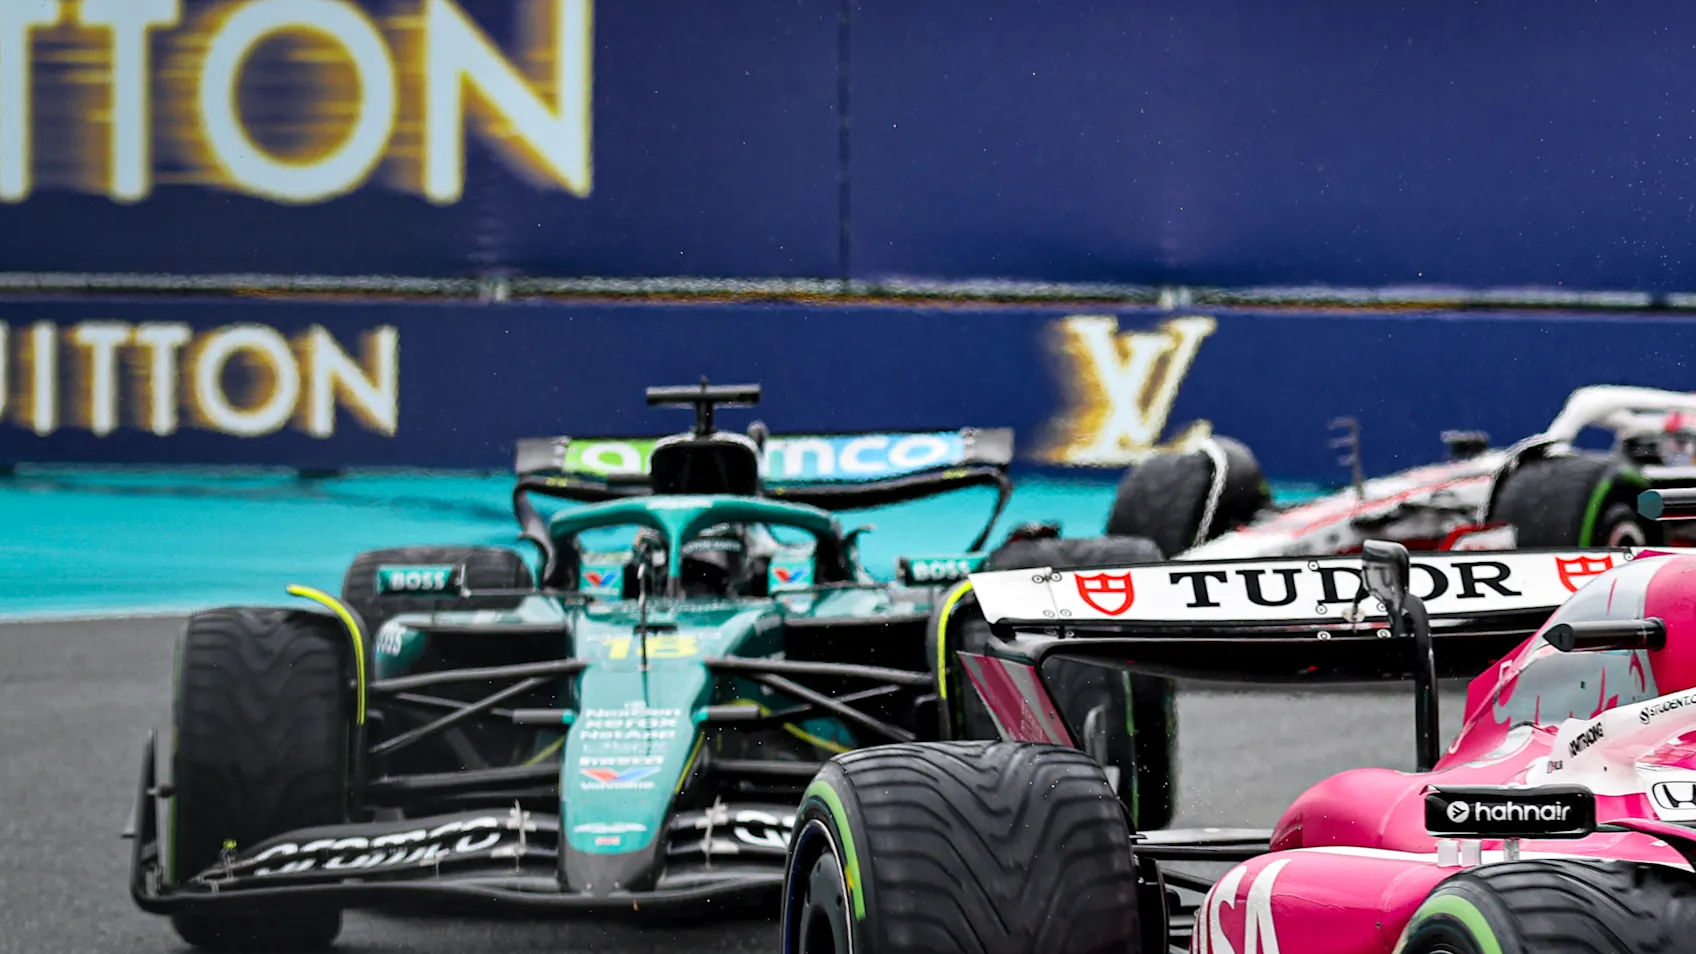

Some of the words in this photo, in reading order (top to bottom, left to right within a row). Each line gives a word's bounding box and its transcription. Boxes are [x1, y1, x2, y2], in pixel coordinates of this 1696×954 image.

[0, 320, 400, 438] ITTON
[389, 571, 446, 591] BOSS
[913, 560, 969, 580] BOSS
[1169, 561, 1522, 608] TUDOR
[603, 635, 698, 660] 18
[1475, 801, 1571, 821] hahnair
